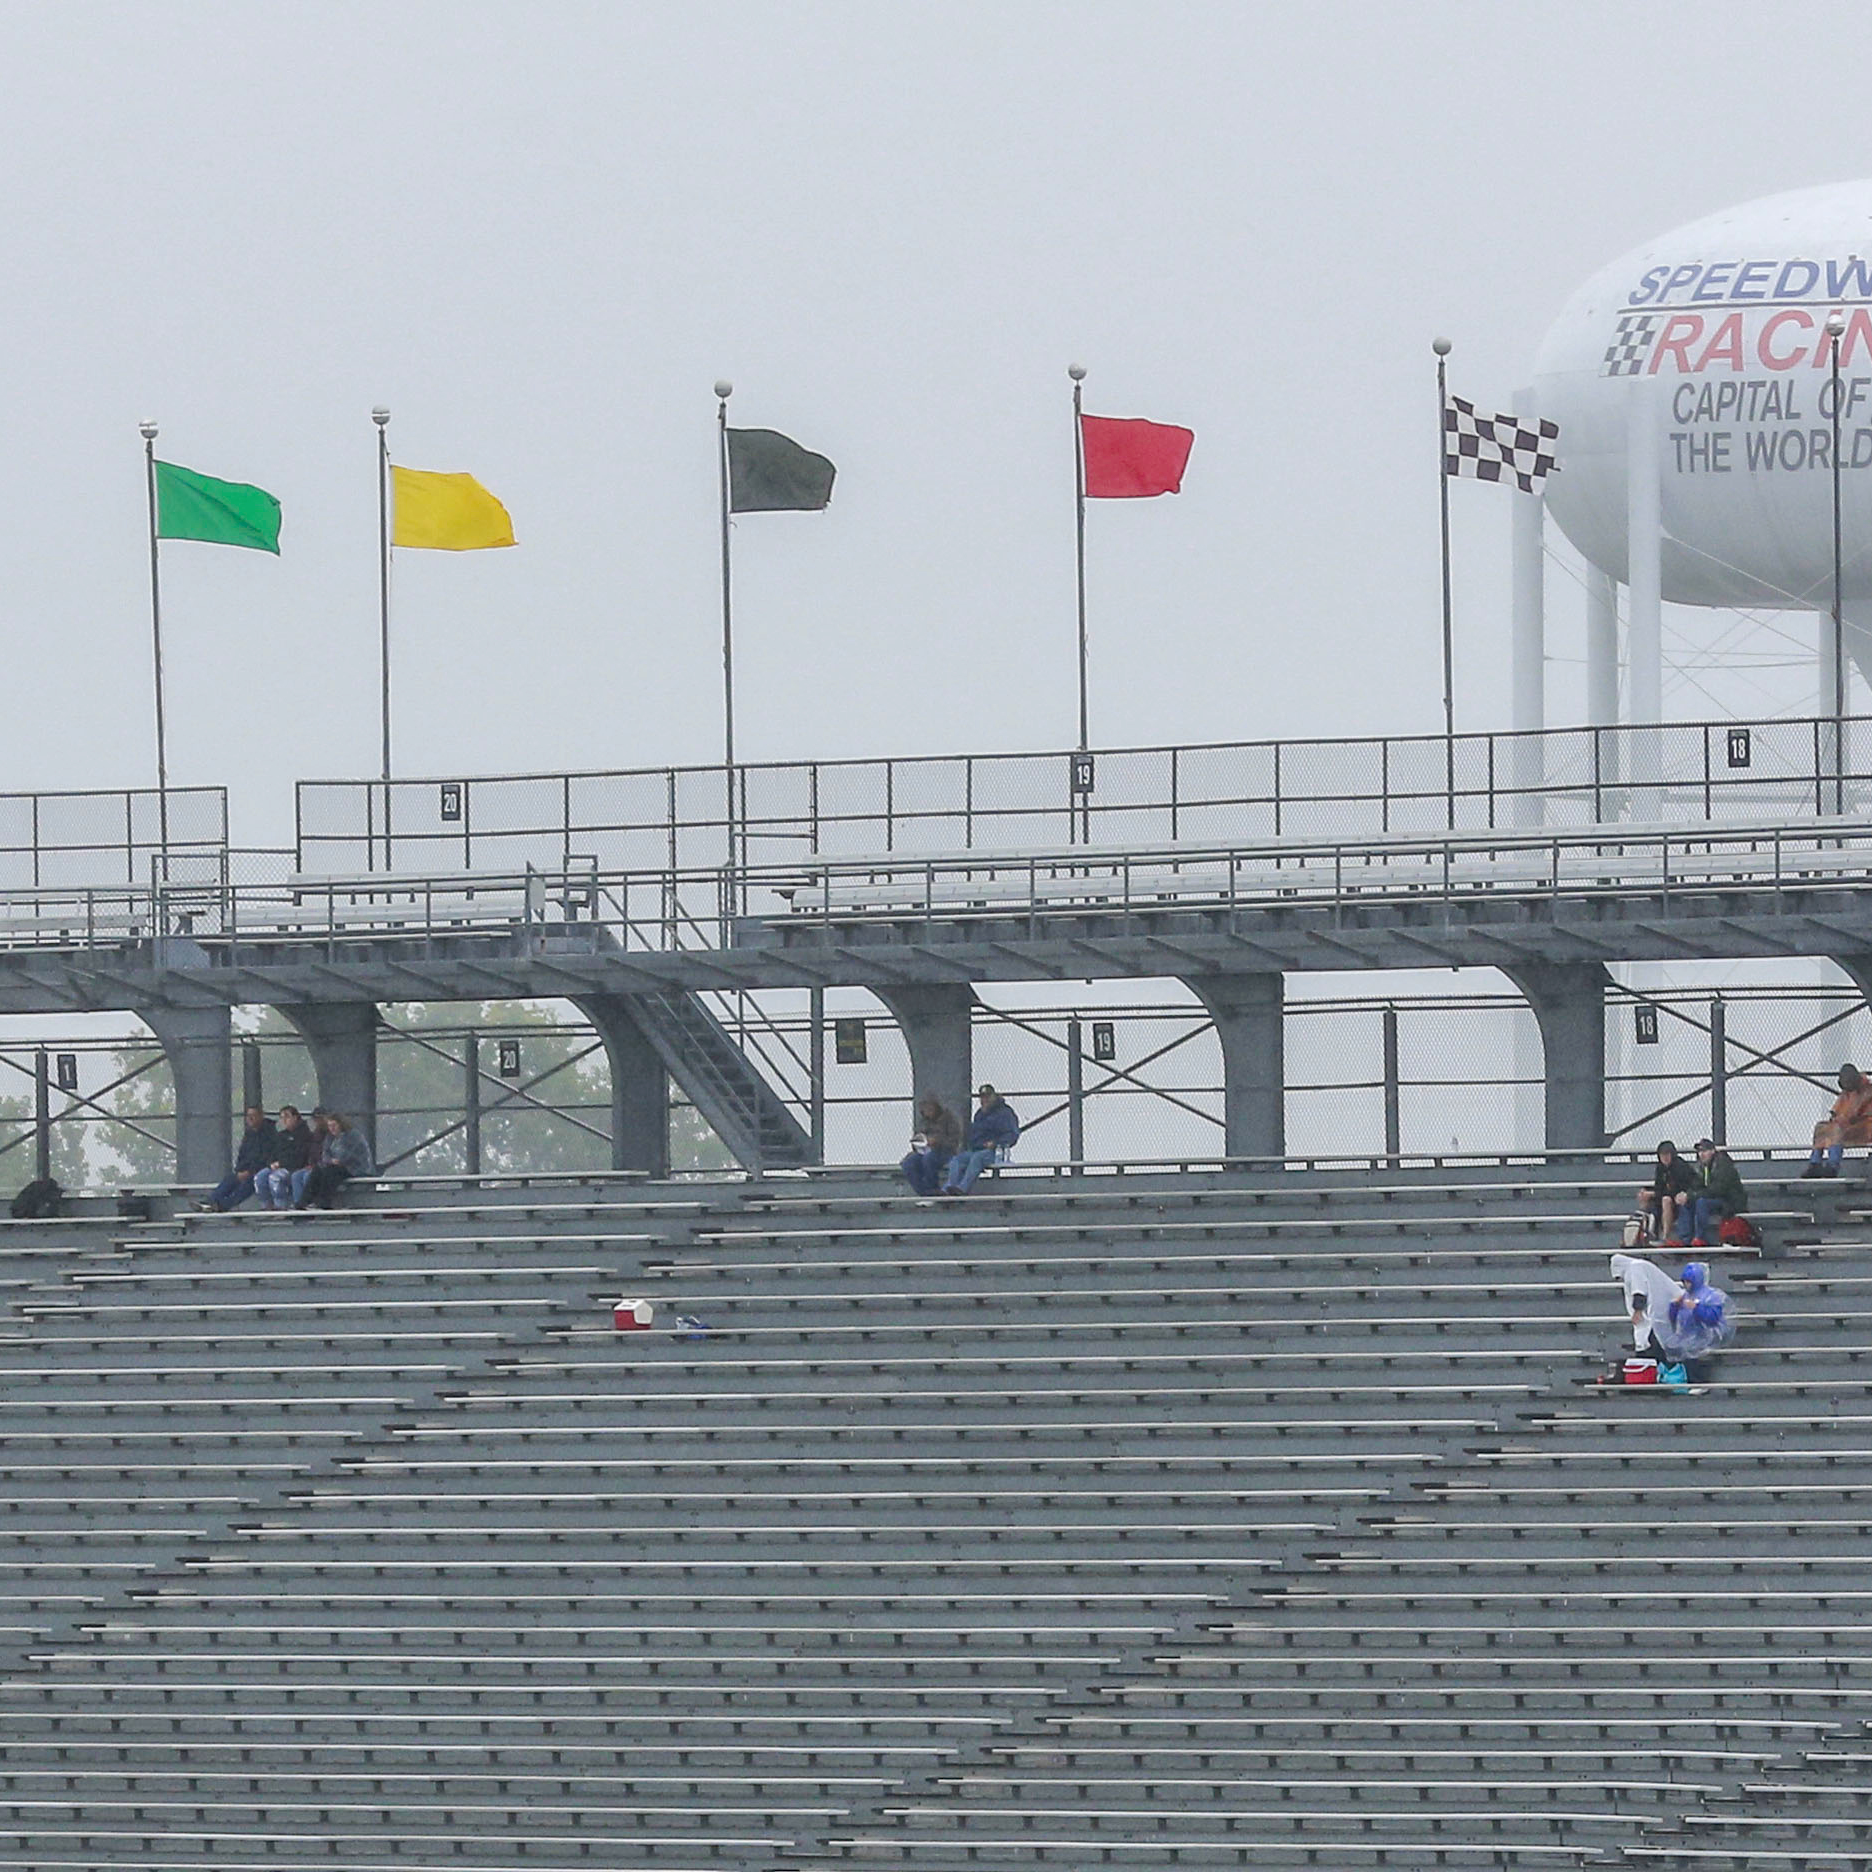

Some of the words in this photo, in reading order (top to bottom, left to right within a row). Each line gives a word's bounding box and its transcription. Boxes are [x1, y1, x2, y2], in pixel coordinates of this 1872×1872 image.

[1672, 379, 1802, 425] CAPITAL
[1818, 377, 1871, 420] OF
[1670, 429, 1732, 473] THE
[1732, 738, 1746, 759] 18
[1077, 765, 1091, 785] 19
[444, 793, 457, 812] 20
[1640, 1015, 1654, 1035] 18
[1097, 1032, 1111, 1052] 19
[503, 1051, 516, 1069] 20
[64, 1064, 70, 1081] 1
